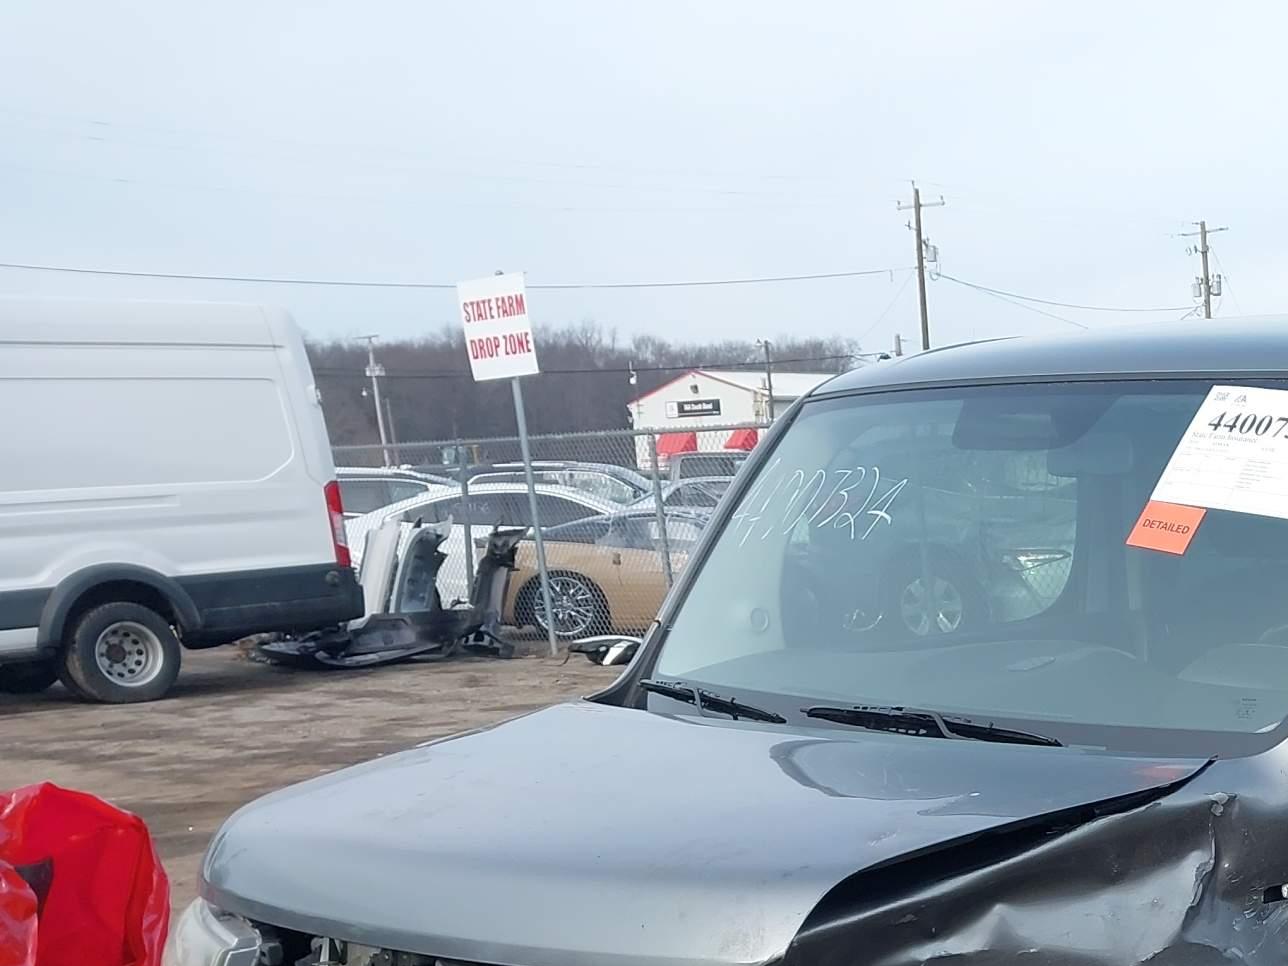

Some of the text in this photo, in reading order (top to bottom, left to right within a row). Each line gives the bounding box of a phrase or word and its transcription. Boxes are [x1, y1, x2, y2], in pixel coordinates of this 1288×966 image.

[463, 293, 526, 323] STATE FARM
[470, 332, 531, 360] DROP ZONE
[1142, 518, 1191, 536] DETAILED
